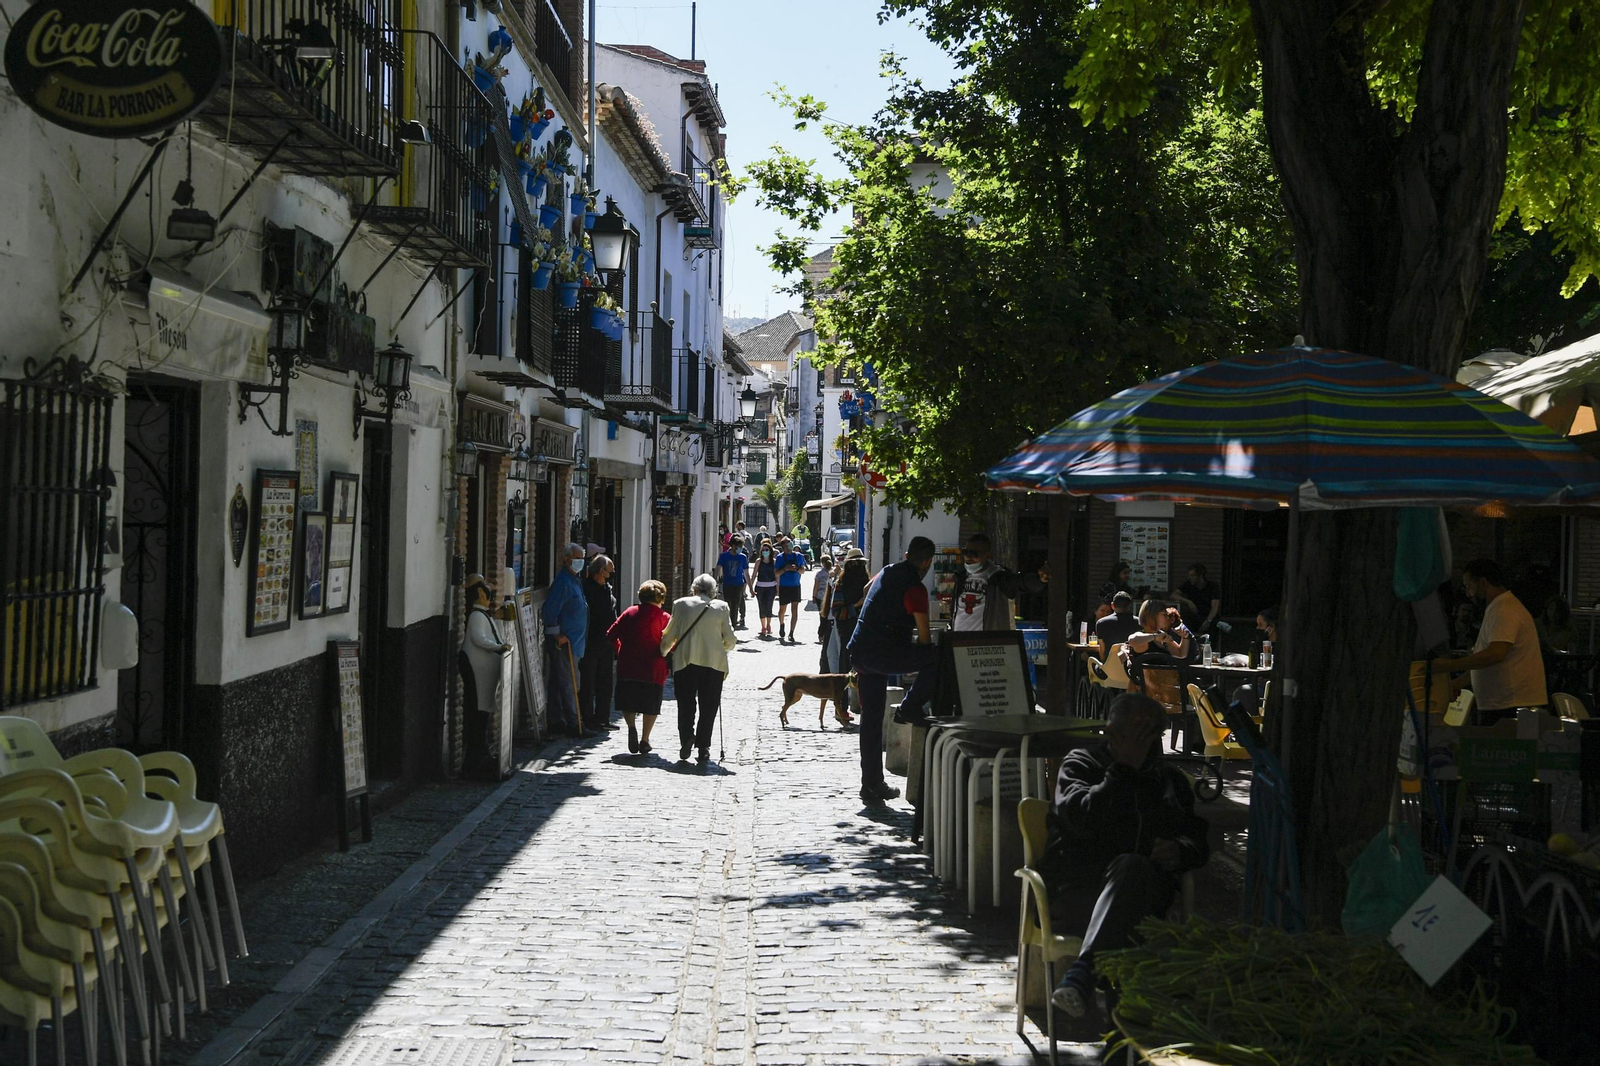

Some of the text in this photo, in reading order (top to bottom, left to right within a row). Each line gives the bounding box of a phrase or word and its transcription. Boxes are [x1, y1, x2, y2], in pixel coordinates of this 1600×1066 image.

[26, 8, 186, 68] Coca-Cola
[55, 83, 178, 118] BAR LA PORRONA
[970, 659, 979, 668] LA
